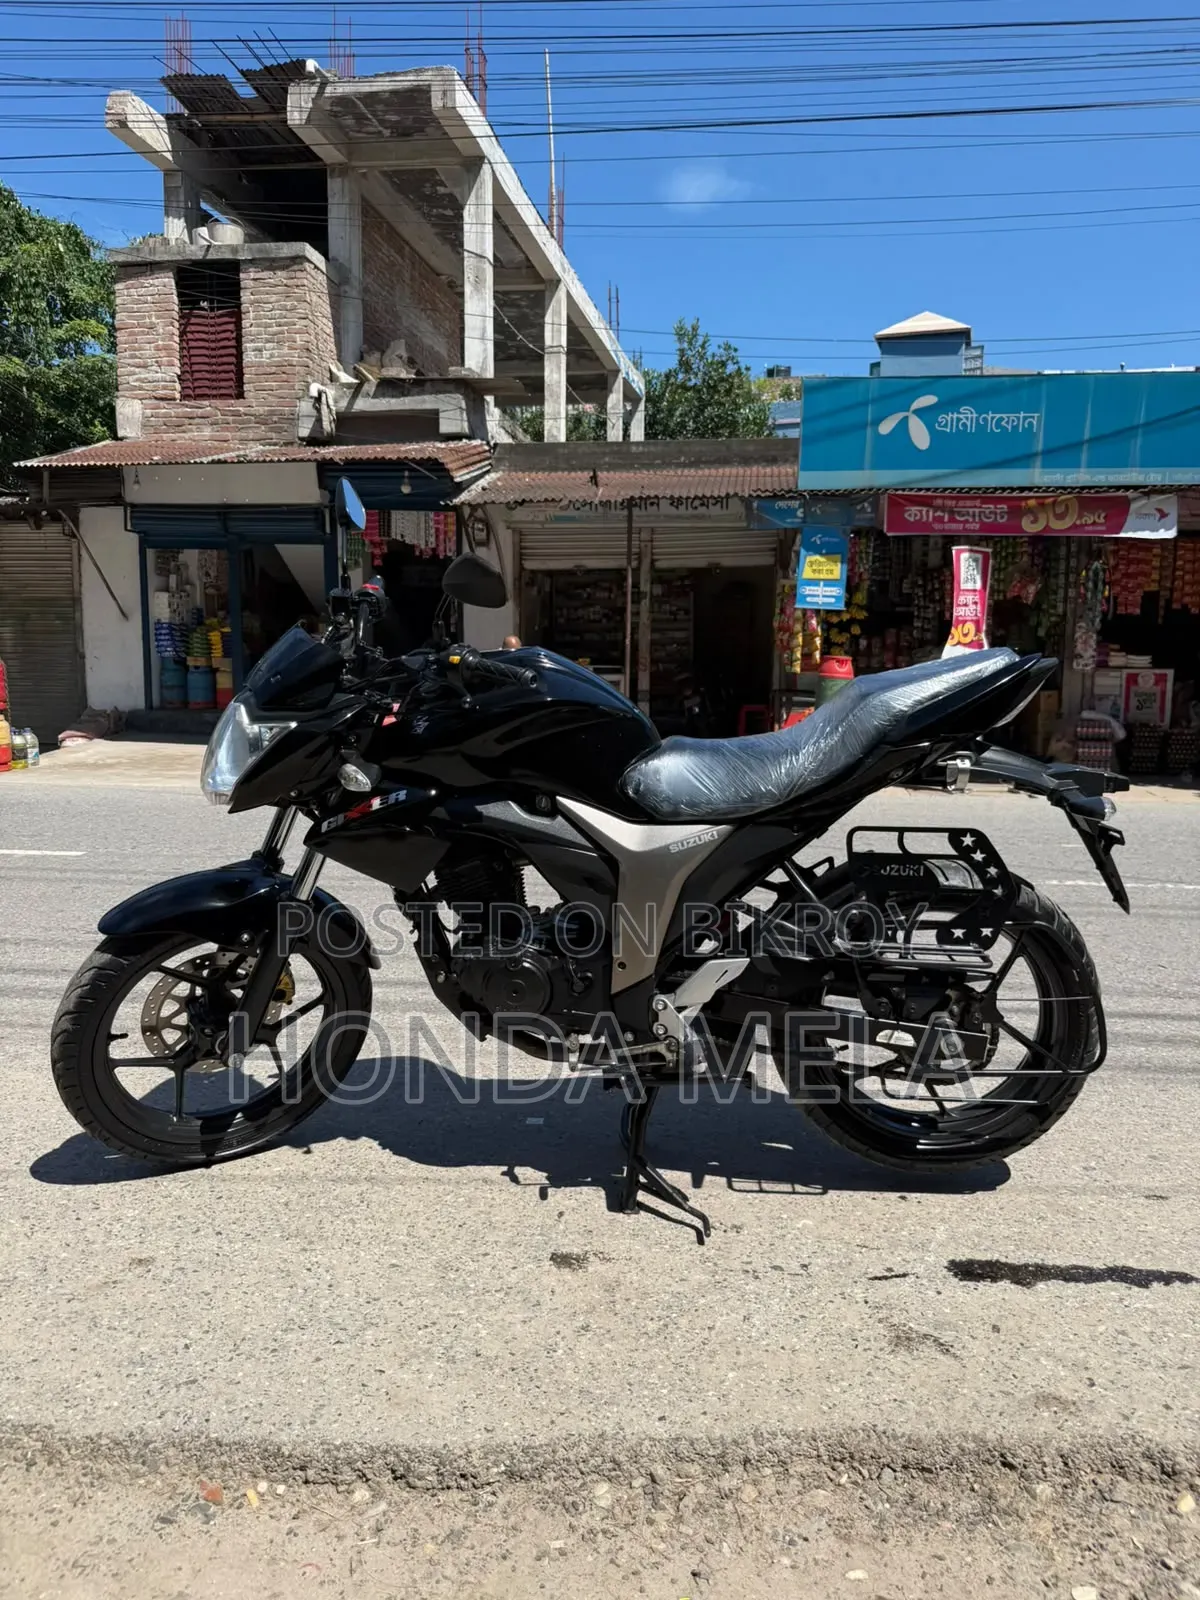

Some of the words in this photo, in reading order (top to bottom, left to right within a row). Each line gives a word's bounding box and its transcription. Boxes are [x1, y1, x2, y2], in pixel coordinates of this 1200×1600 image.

[935, 406, 1040, 433] গ্রামীণফোন
[904, 506, 949, 523] ক্যাশ
[953, 503, 1008, 523] আউট
[669, 830, 719, 854] SUZUKI
[874, 863, 925, 877] UZUKI
